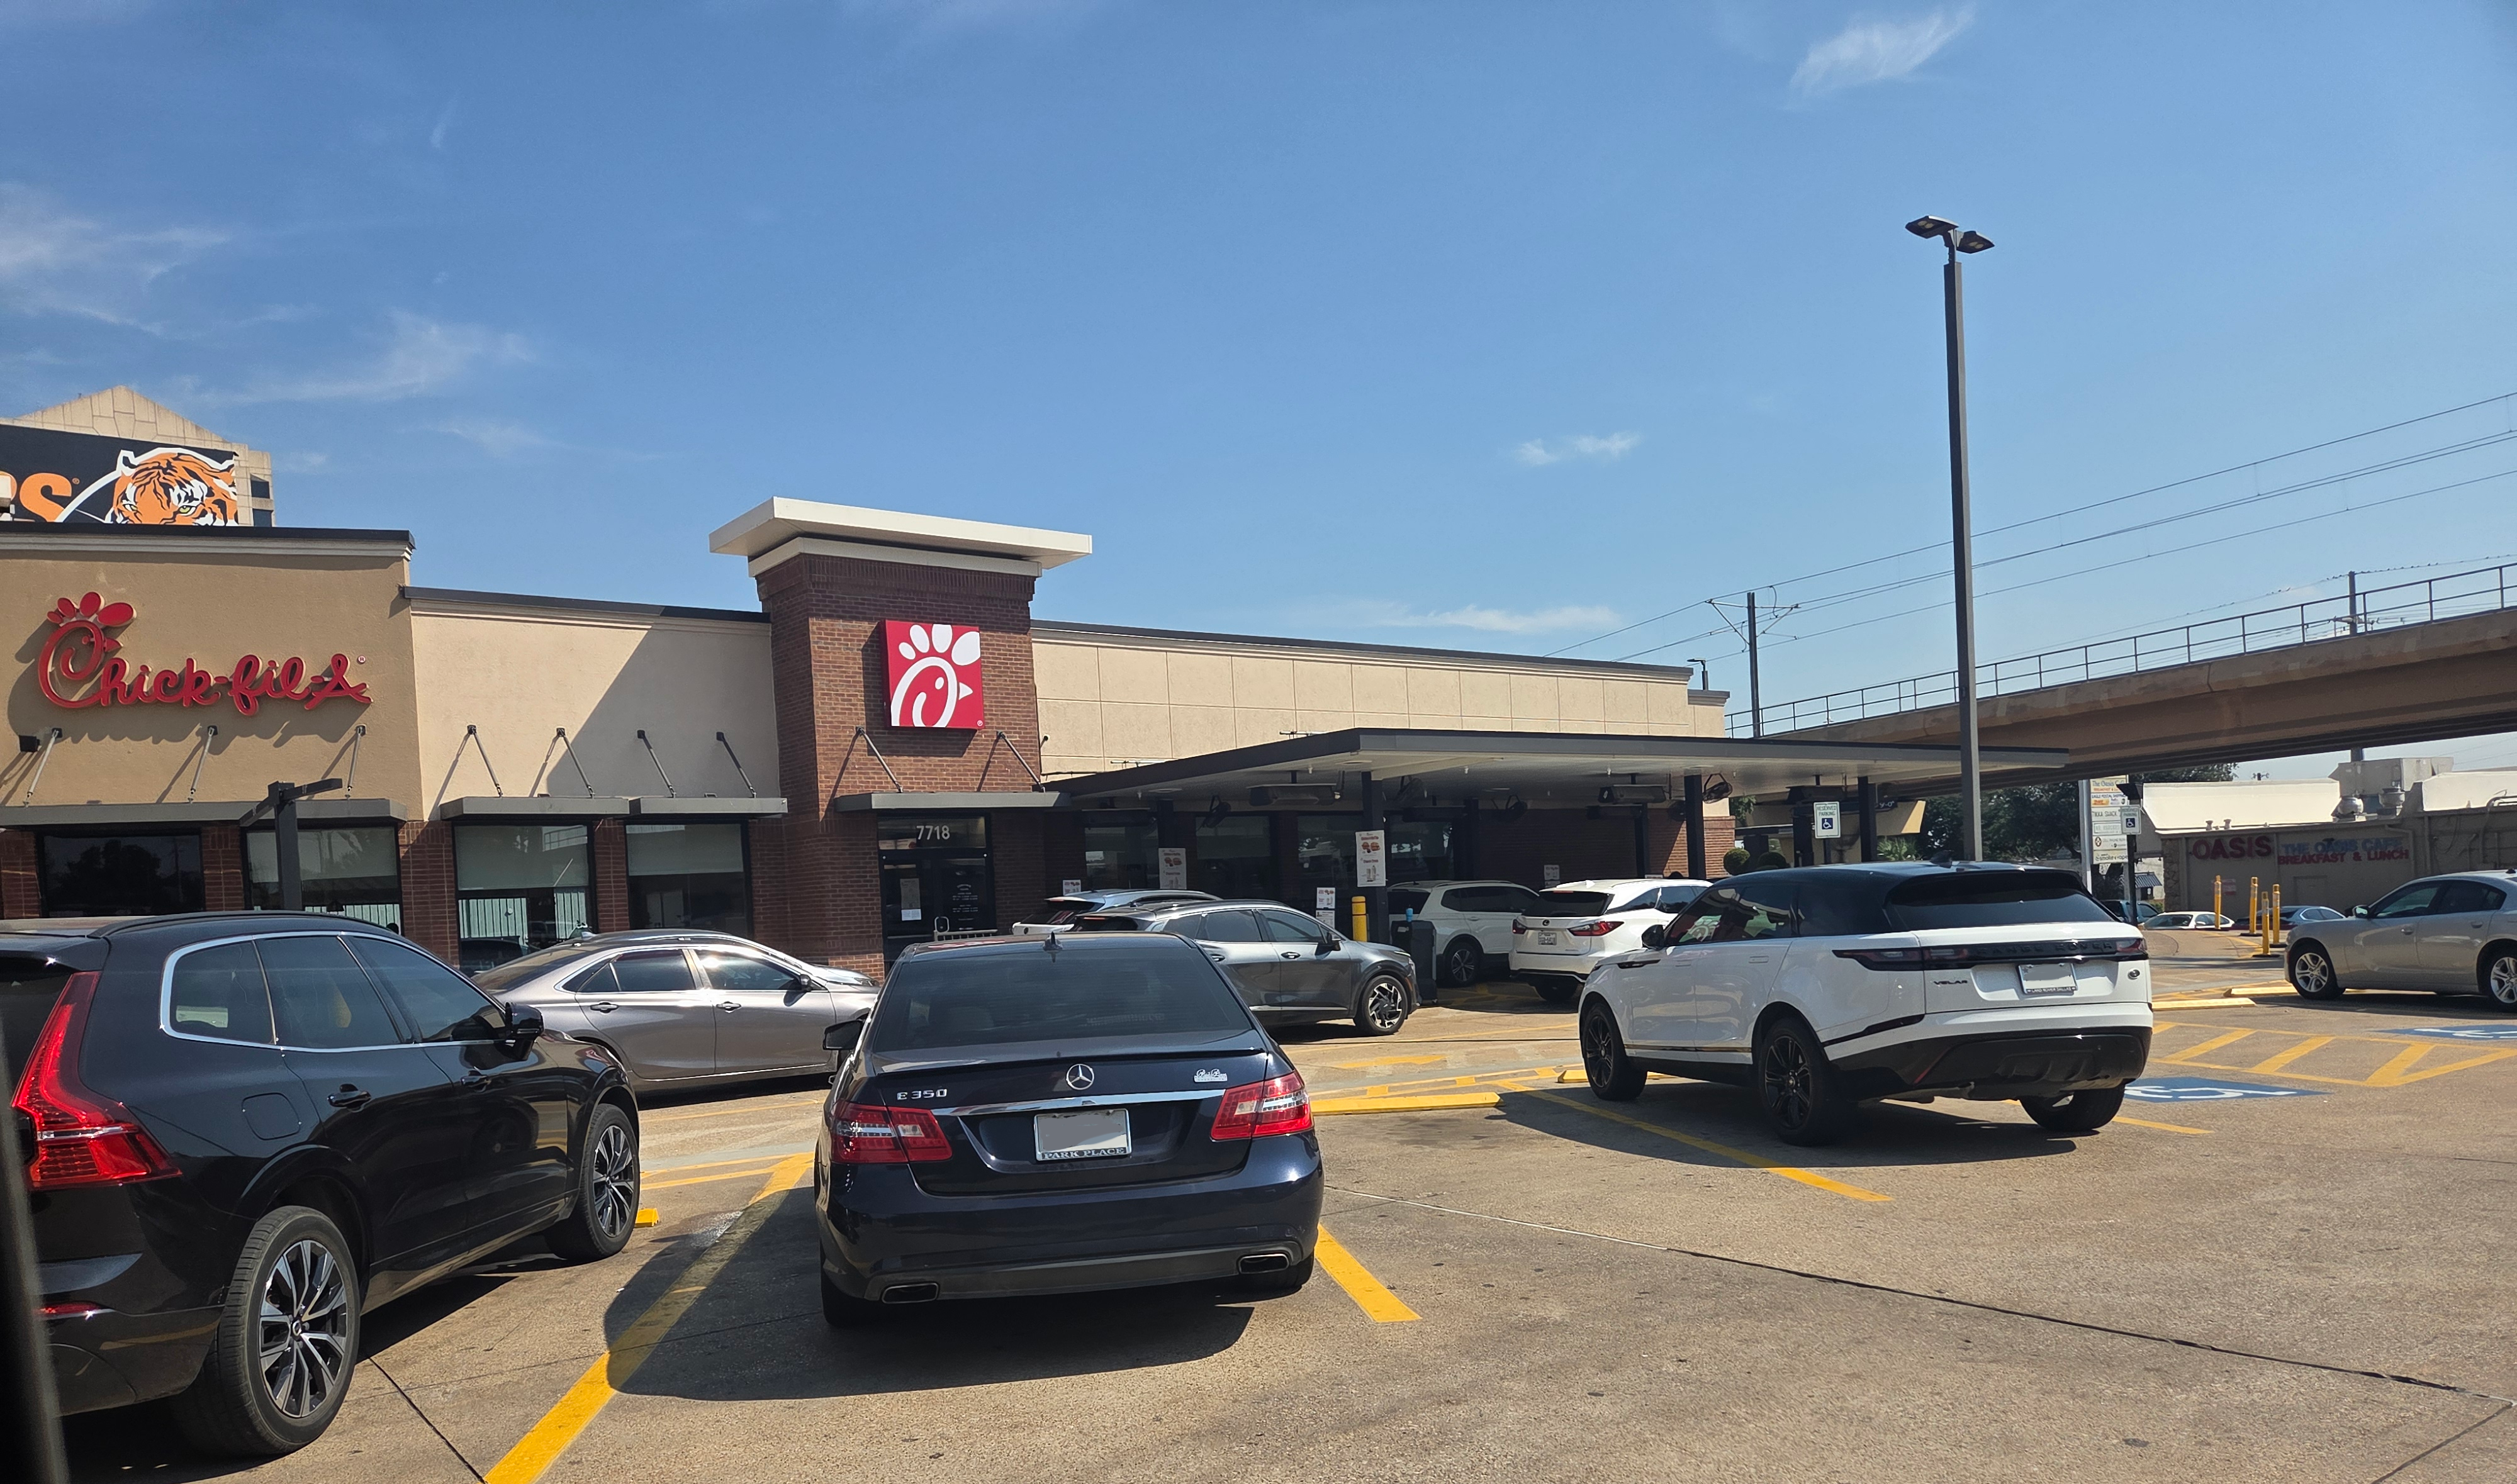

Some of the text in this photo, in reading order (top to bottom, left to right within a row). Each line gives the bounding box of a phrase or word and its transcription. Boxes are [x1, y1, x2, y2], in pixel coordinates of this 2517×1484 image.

[38, 613, 373, 716] Chick-fil-A
[916, 825, 950, 840] 7718
[2192, 835, 2272, 860] OASIS
[2282, 842, 2309, 854] THE
[2314, 839, 2358, 853] OASIS
[2277, 849, 2409, 866] BREAKFAST & LUNCH
[2055, 942, 2112, 951] ROVER
[897, 1088, 947, 1100] E 350
[1083, 1148, 1124, 1156] PLACE
